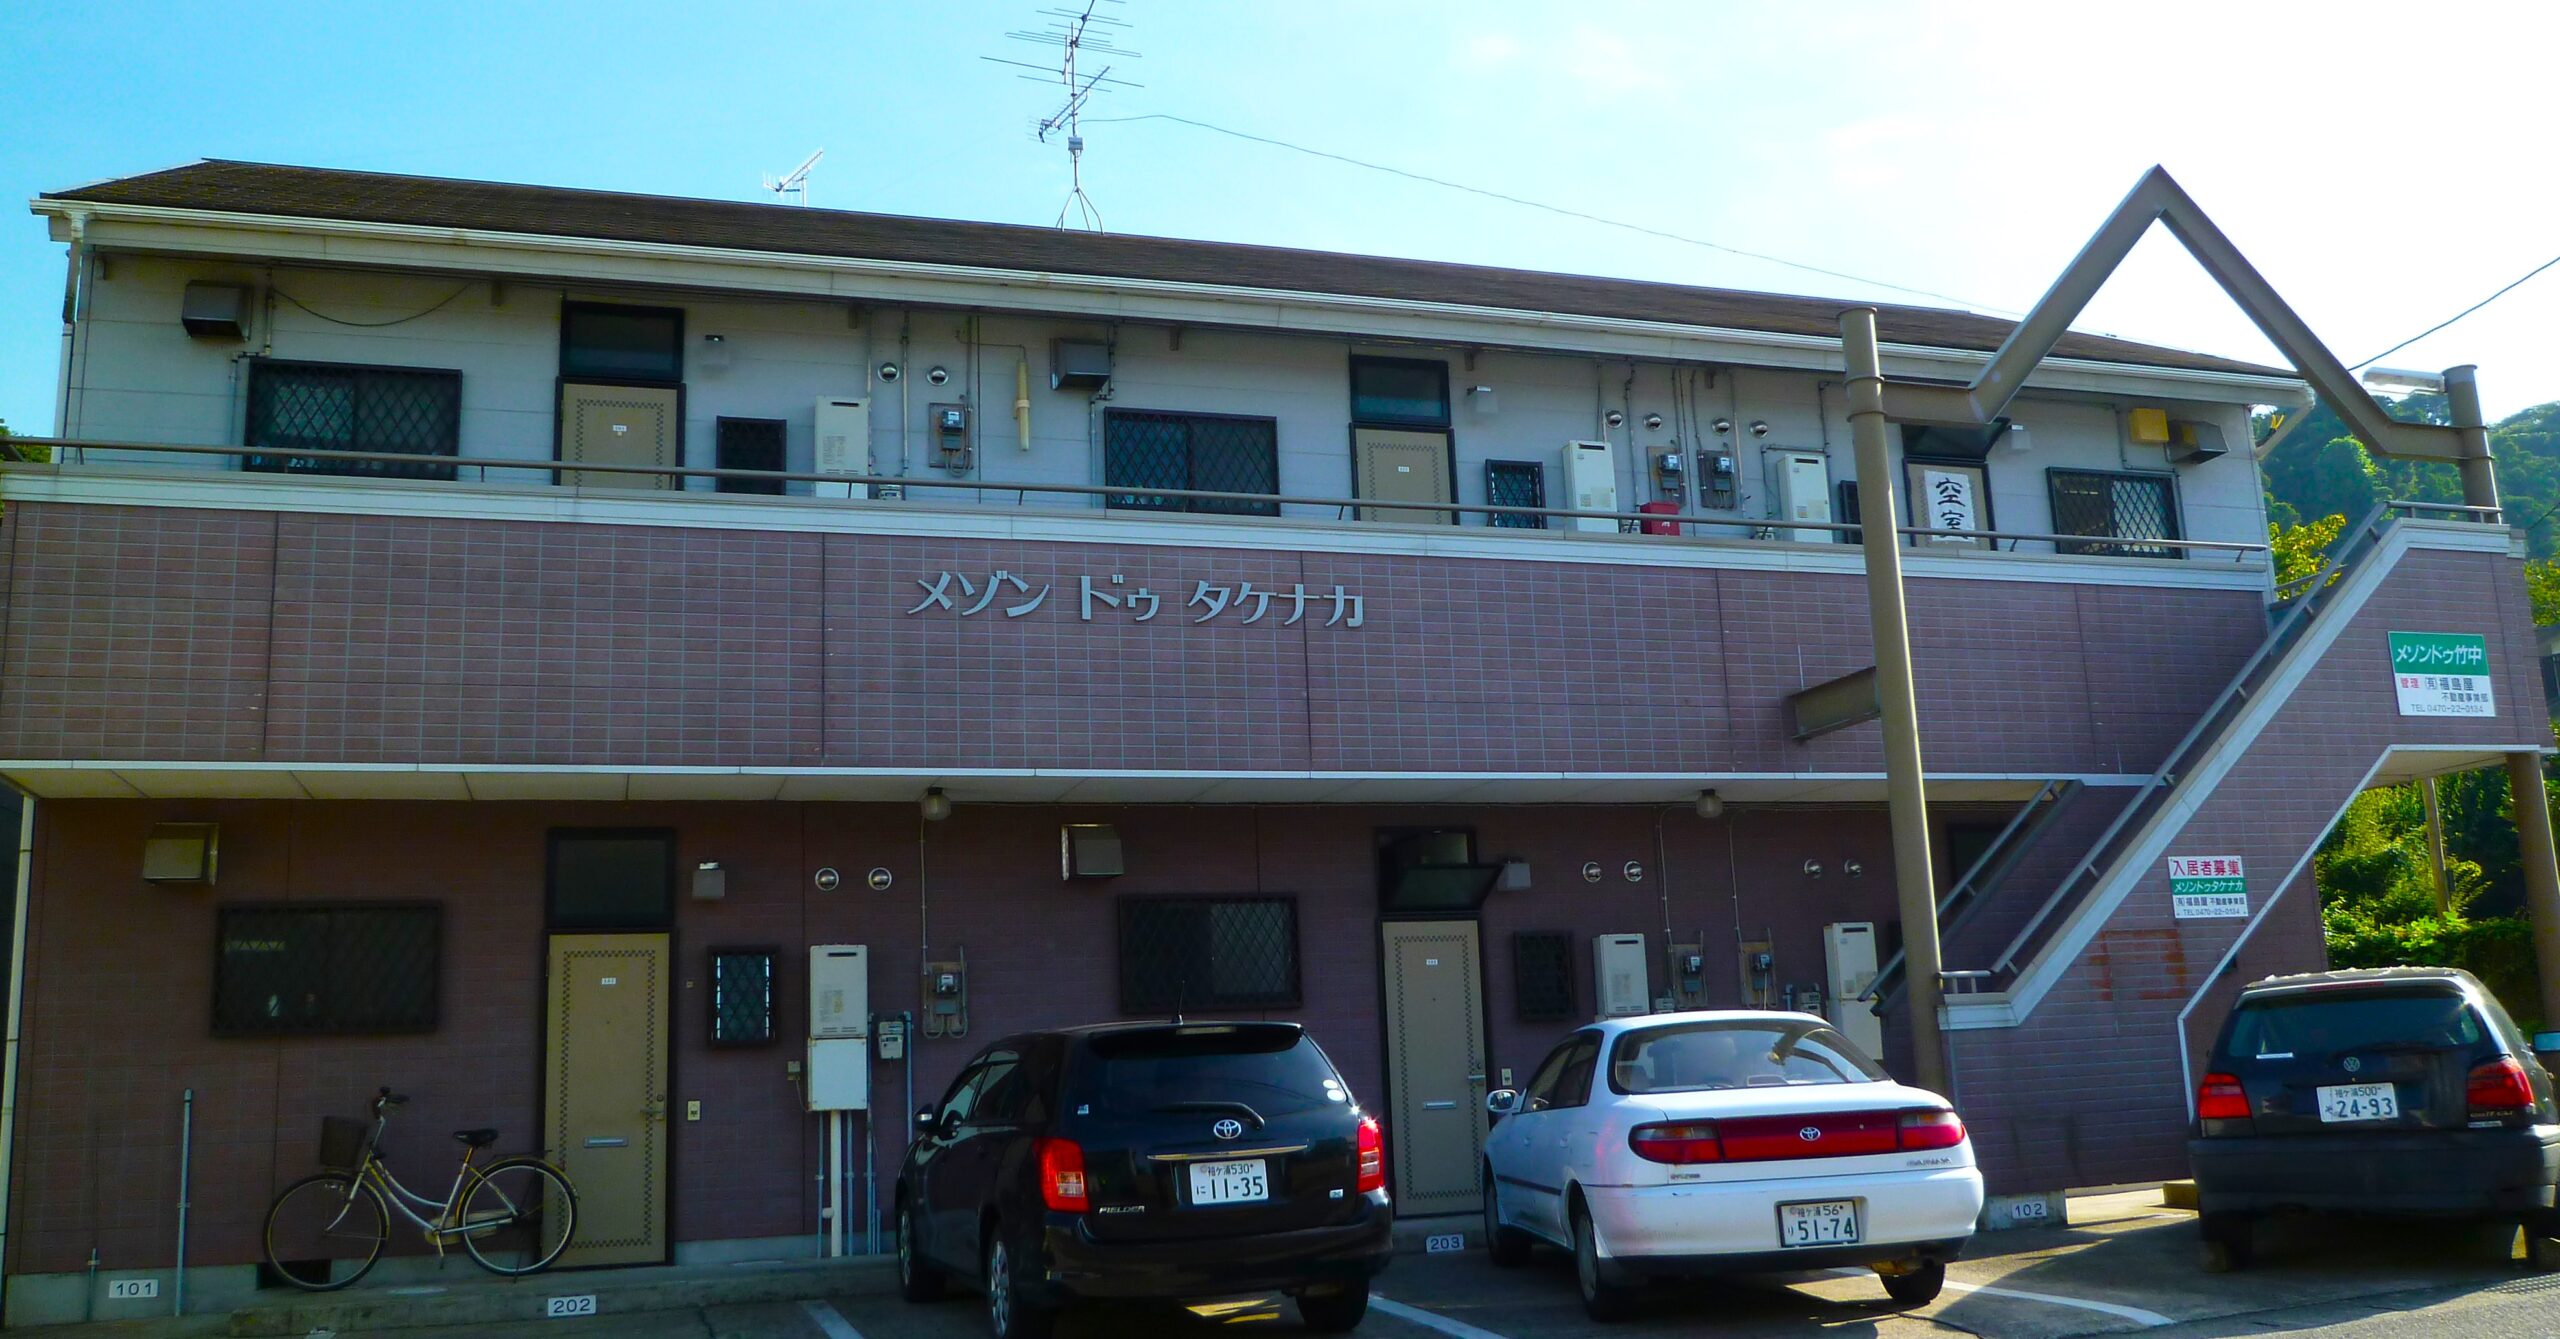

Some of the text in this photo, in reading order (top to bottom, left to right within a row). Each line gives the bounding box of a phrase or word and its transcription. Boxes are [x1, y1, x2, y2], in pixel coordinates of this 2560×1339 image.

[907, 570, 1364, 628] メゾン ドゥ タケナカ
[2172, 859, 2241, 877] 入居者募集
[2336, 1097, 2393, 1118] 24-93
[1196, 1175, 1264, 1200] に 11-35
[2015, 1203, 2043, 1217] 102
[1797, 1217, 1854, 1241] 51-74
[1430, 1236, 1460, 1250] 203
[116, 1282, 152, 1296] 101
[553, 1298, 591, 1313] 202
